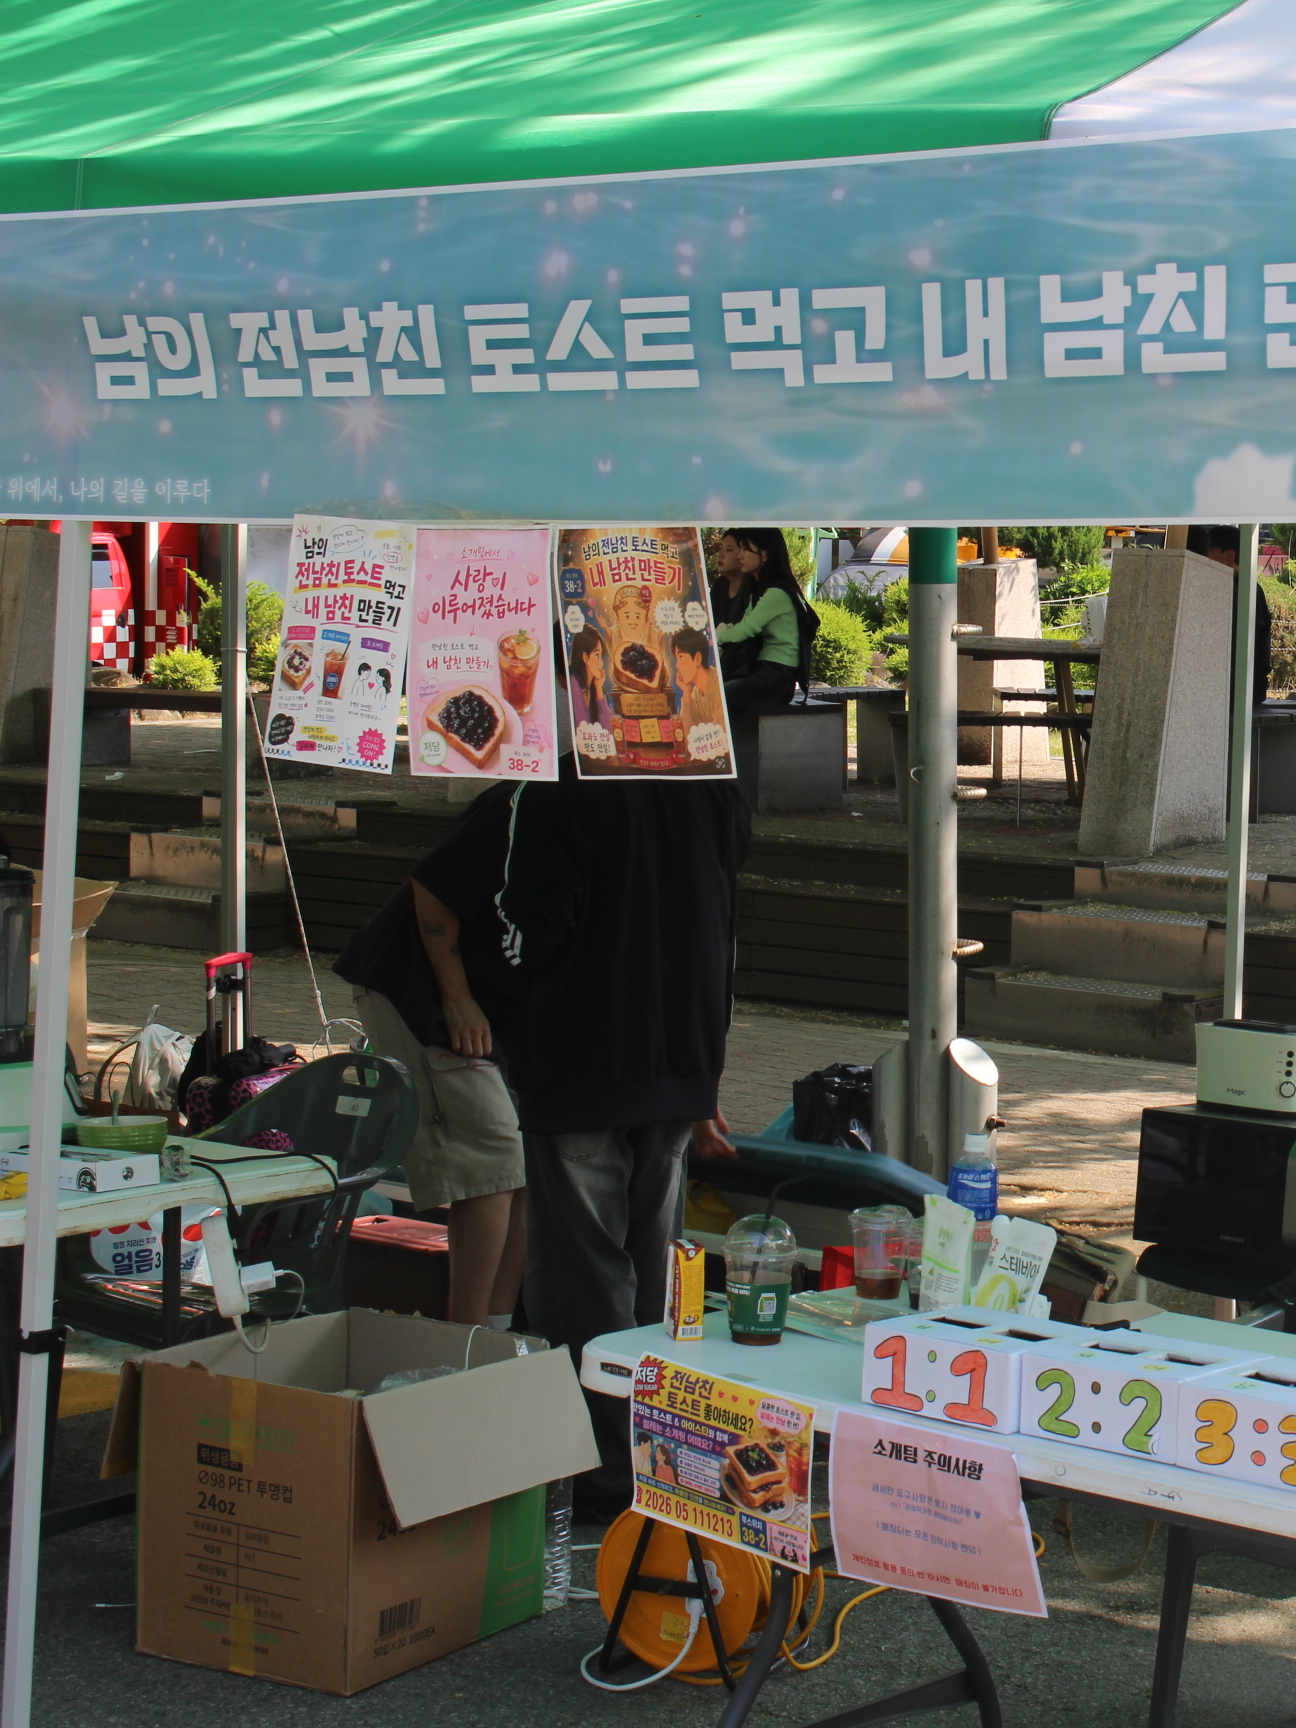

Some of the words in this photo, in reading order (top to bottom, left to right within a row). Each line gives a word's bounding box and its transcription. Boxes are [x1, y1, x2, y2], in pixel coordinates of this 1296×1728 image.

[82, 312, 218, 399] 남의
[229, 301, 447, 398] 전남친
[463, 295, 700, 393] 토스트
[721, 286, 893, 388] 먹고
[922, 277, 1008, 381] 내
[1039, 262, 1227, 378] 남친
[8, 477, 63, 503] 위에서,
[71, 477, 104, 503] 나의
[113, 478, 148, 504] 길을
[156, 478, 211, 505] 이루다
[303, 537, 329, 559] 남의
[582, 541, 600, 561] 남의
[600, 535, 628, 554] 전남친
[631, 535, 660, 552] 토스트
[660, 540, 679, 560] 먹고
[295, 560, 341, 590] 전남친
[342, 559, 385, 588] 토스트
[384, 579, 406, 600] 먹고
[450, 566, 507, 593] 사랑이
[564, 581, 582, 593] 38-2
[588, 565, 604, 588] 내
[609, 557, 637, 584] 남친
[638, 557, 683, 592] 만들기
[304, 595, 319, 619] 내
[324, 593, 354, 621] 남친
[357, 598, 402, 628] 만들기
[431, 593, 537, 624] 이루어졌습니다
[426, 656, 439, 671] 내
[442, 656, 462, 671] 남친
[465, 656, 490, 671] 만들기
[362, 741, 380, 750] COME
[423, 741, 440, 752] 저당
[508, 757, 539, 773] 38-2
[1226, 1087, 1246, 1097] Magic
[112, 1249, 154, 1276] 얼음
[998, 1253, 1041, 1280] 스테비아
[635, 1366, 658, 1383] 저당
[669, 1369, 715, 1401] 전남친
[870, 1334, 998, 1428] 1:1
[652, 1409, 673, 1425] 토스트
[681, 1420, 715, 1439] 아이스티와
[666, 1390, 701, 1417] 토스트
[703, 1403, 754, 1435] 좋아하세요?
[1035, 1367, 1163, 1455] 2:2
[664, 1426, 686, 1442] 소개팅
[872, 1439, 918, 1464] 소개팅
[923, 1449, 984, 1481] 주의사항
[228, 1475, 253, 1494] PET
[256, 1480, 293, 1504] 투명컵
[197, 1491, 236, 1516] 24oz
[645, 1489, 672, 1515] 2026
[675, 1500, 688, 1521] 05
[692, 1507, 733, 1537] 111213
[741, 1515, 763, 1531] 부스위치
[742, 1527, 766, 1549] 38-2
